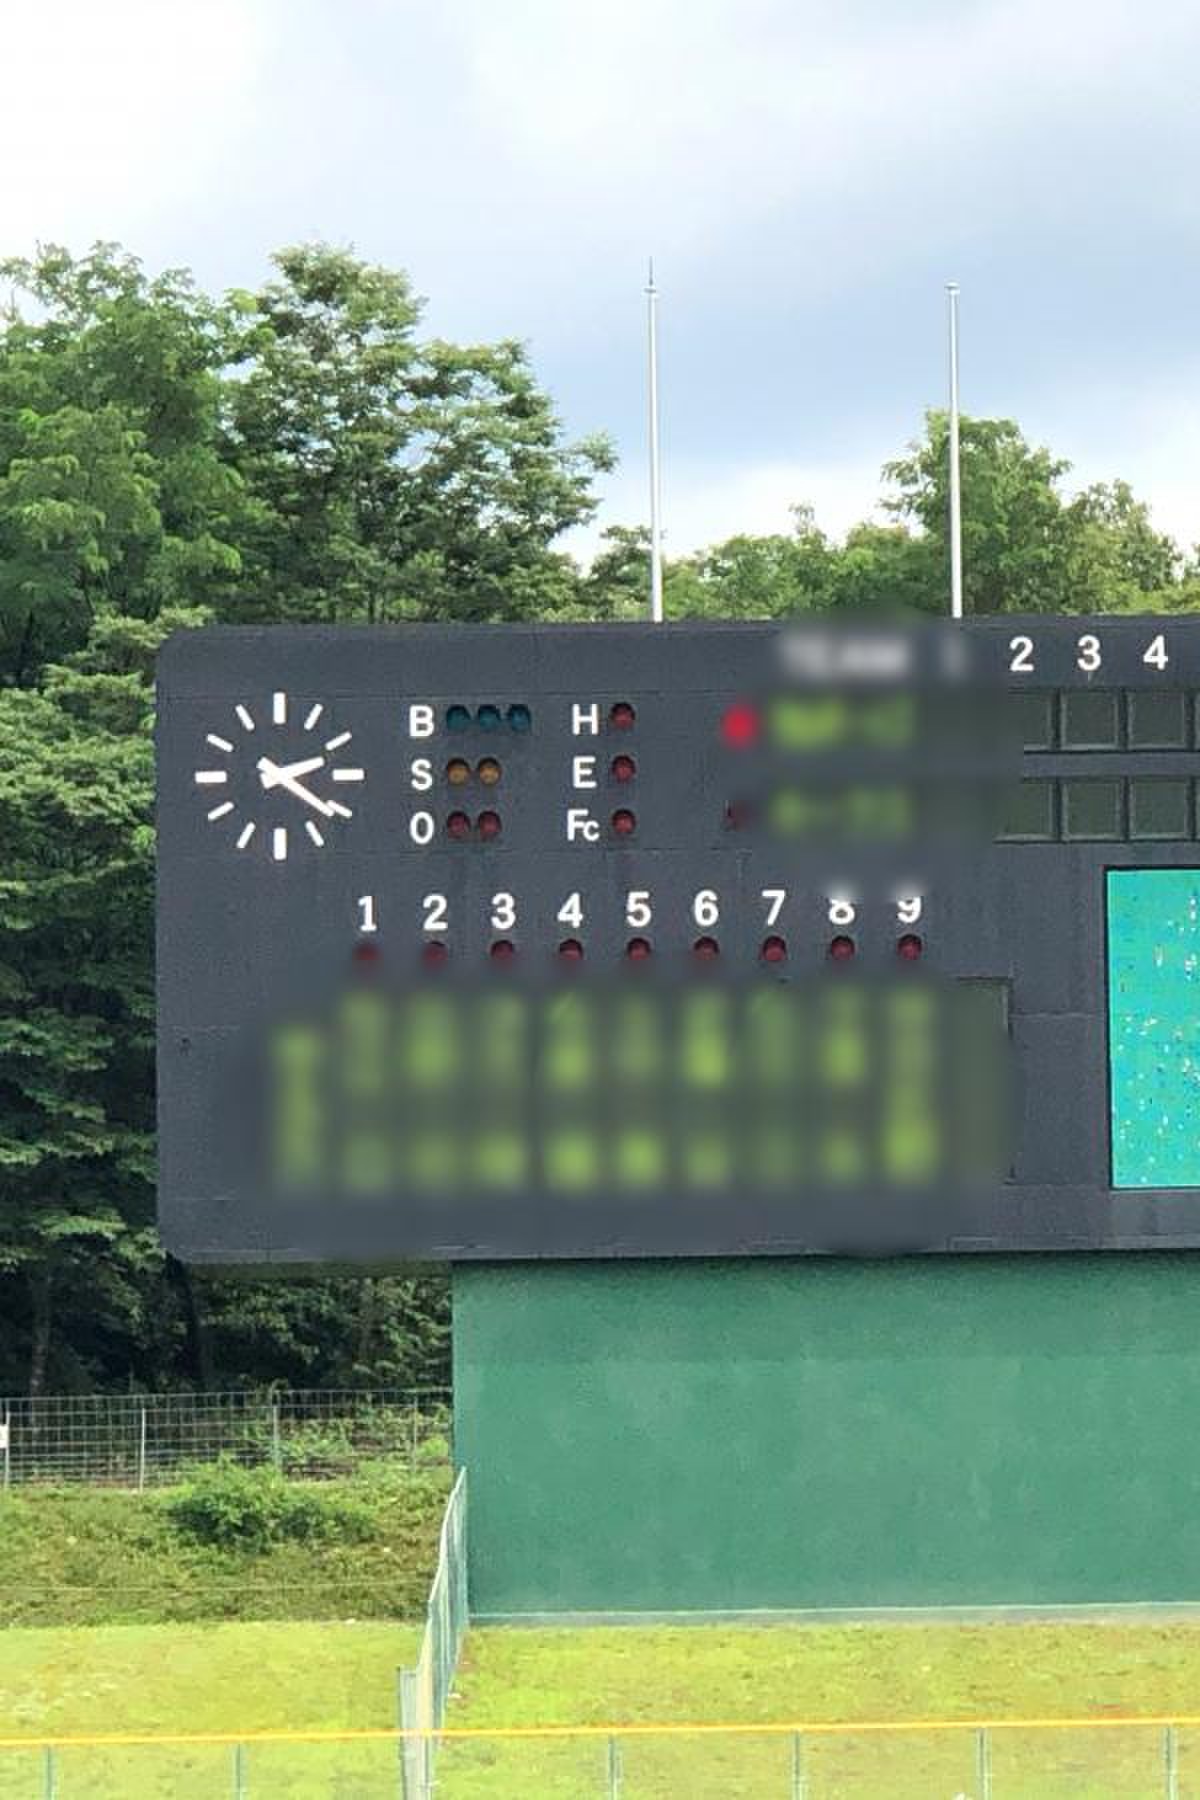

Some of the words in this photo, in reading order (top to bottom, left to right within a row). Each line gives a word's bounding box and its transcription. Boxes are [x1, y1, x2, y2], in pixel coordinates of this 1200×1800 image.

[1009, 635, 1035, 672] 2
[1077, 634, 1102, 672] 3
[1142, 634, 1169, 670] 4
[409, 704, 435, 739] B
[572, 703, 599, 736] H
[410, 758, 433, 791] S
[572, 755, 597, 789] E
[566, 808, 600, 842] Fc
[358, 895, 377, 932] 1
[422, 893, 449, 932] 2
[490, 892, 517, 931] 3
[557, 892, 584, 929] 4
[626, 890, 652, 928] 5
[693, 889, 719, 927] 6
[761, 889, 786, 926] 7
